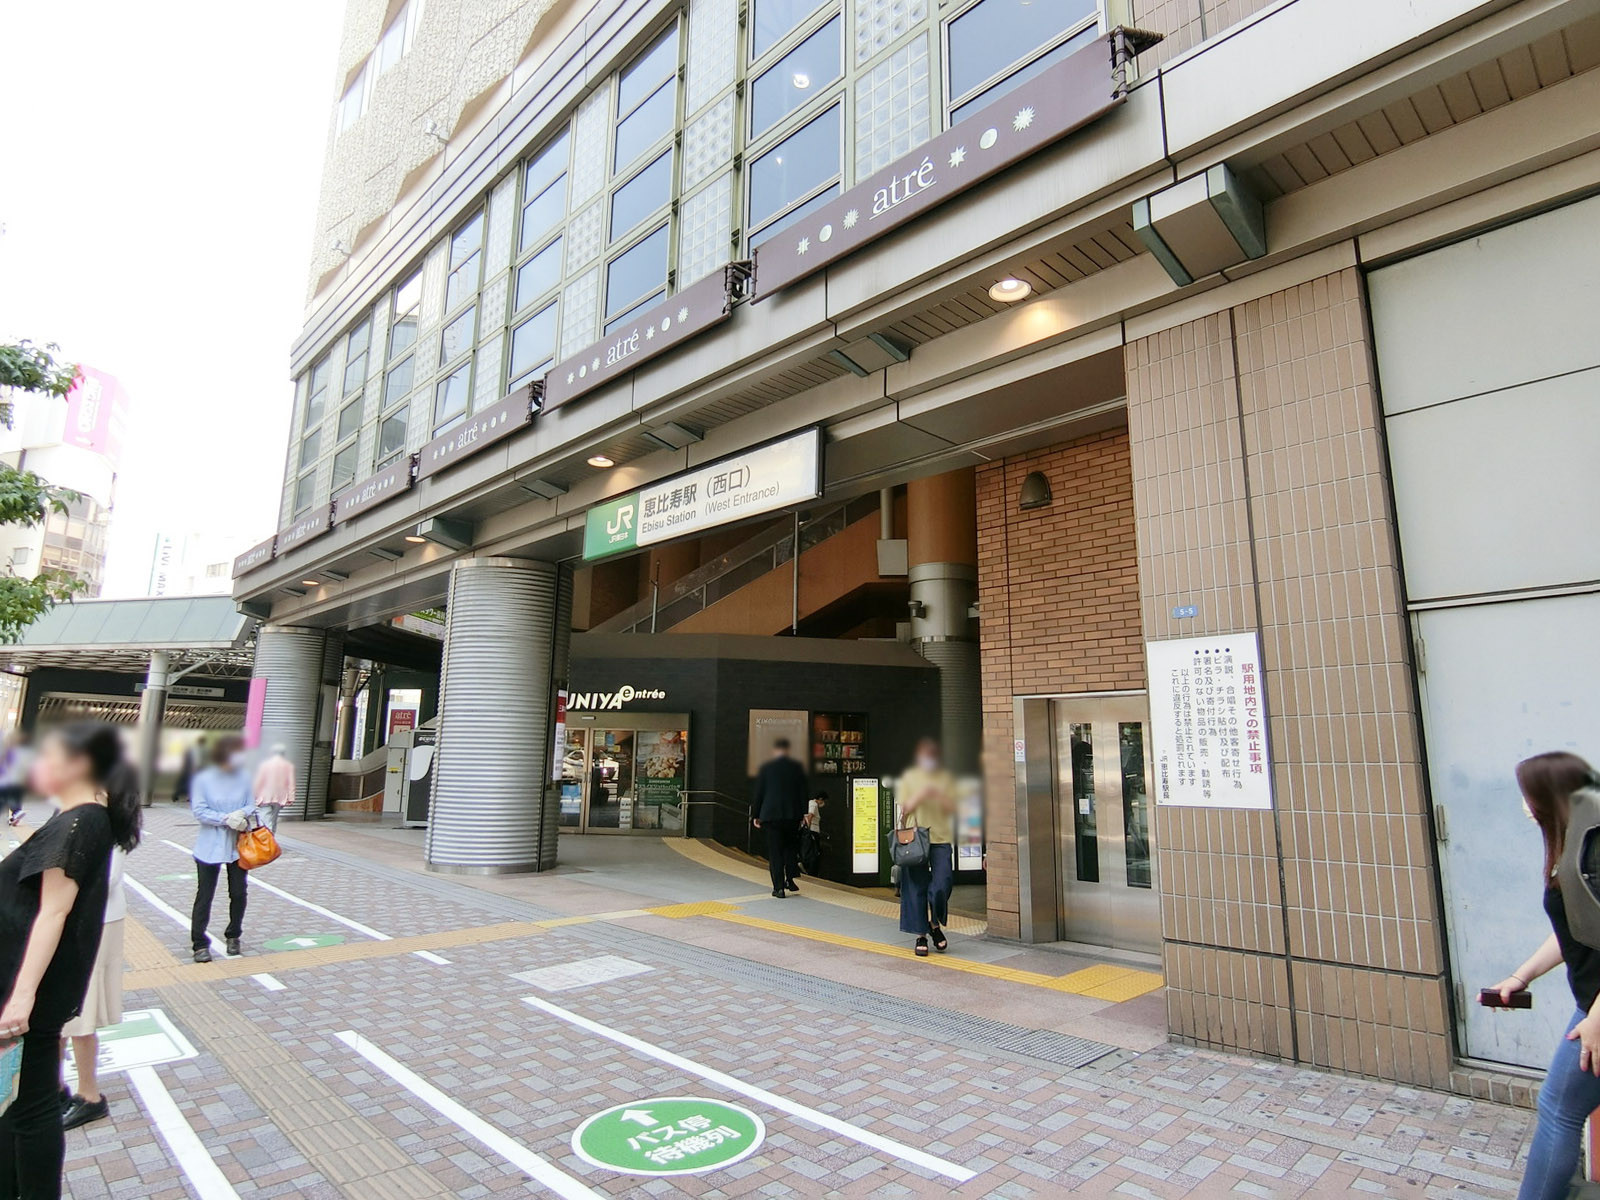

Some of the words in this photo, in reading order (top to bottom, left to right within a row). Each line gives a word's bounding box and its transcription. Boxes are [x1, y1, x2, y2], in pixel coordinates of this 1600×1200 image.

[872, 156, 935, 215] atré
[606, 328, 640, 365] atré
[606, 504, 634, 535] JR
[641, 517, 665, 534] Ebisu
[666, 509, 697, 527] Station
[704, 496, 731, 517] (West
[732, 481, 780, 507] Entrance)
[619, 685, 666, 702] entrée
[1241, 663, 1263, 774] 駅用地内での禁止事項
[627, 1114, 712, 1150] バス停
[644, 1125, 742, 1165] 待機列
